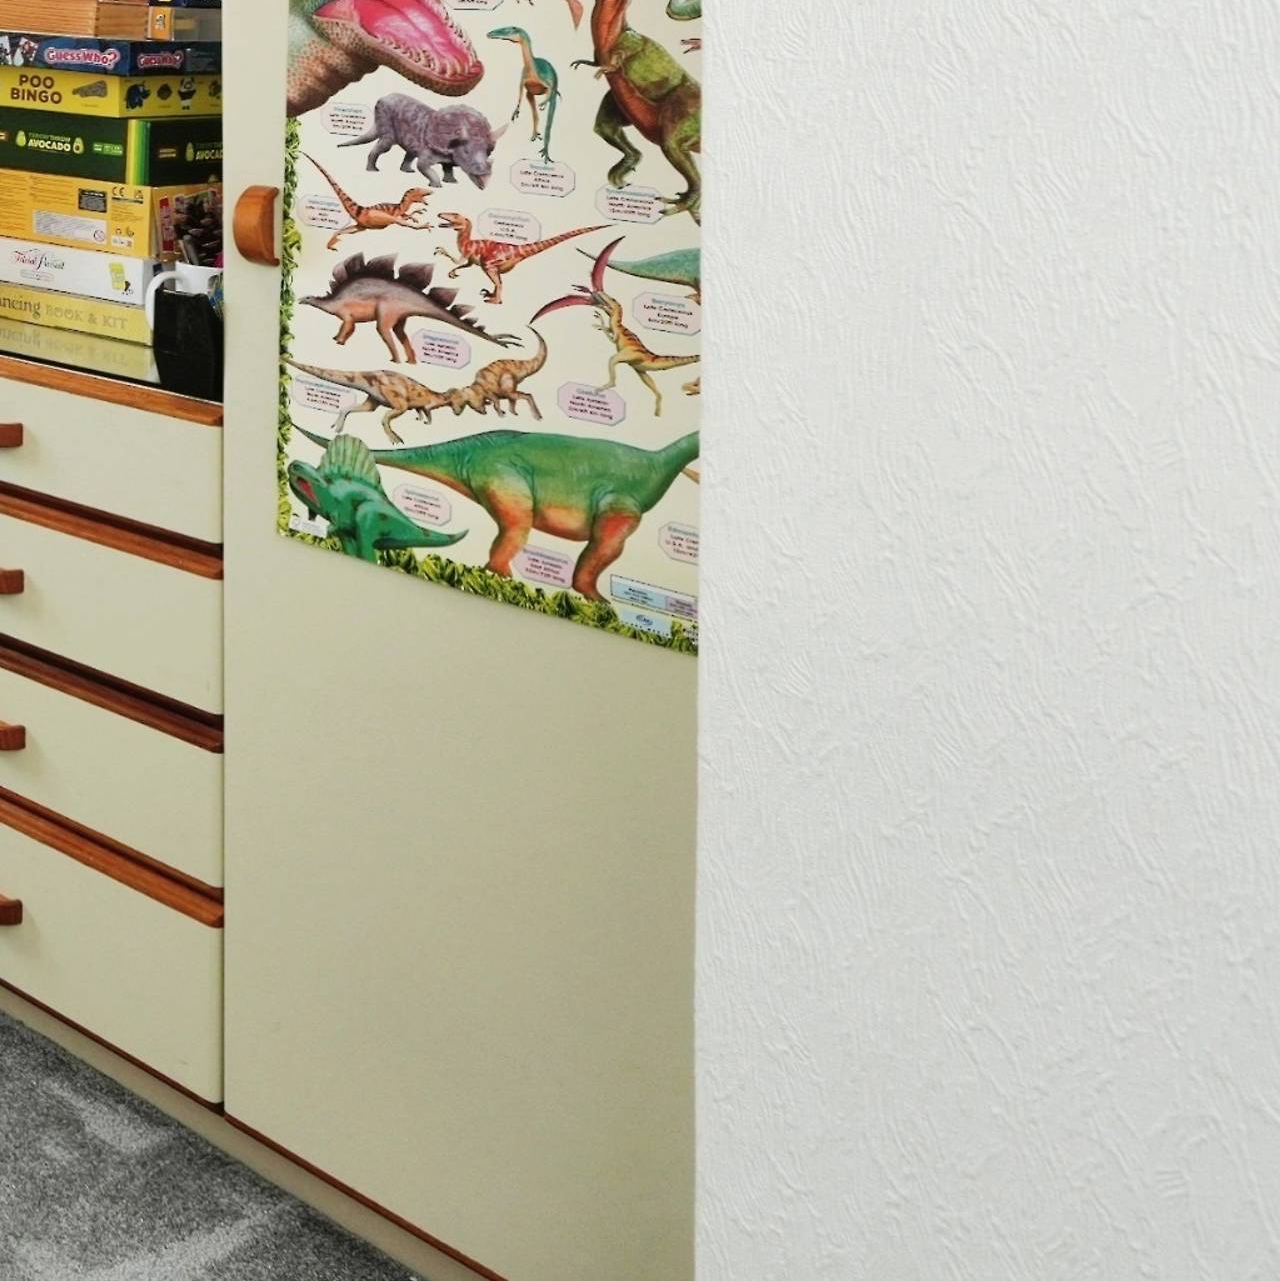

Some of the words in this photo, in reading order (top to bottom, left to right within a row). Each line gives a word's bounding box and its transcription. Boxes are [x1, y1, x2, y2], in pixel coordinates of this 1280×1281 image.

[19, 74, 55, 89] POO
[10, 87, 62, 104] BINGO
[28, 139, 71, 152] AVOCADO
[195, 149, 223, 160] AVOCA
[45, 303, 84, 321] BOOK
[87, 312, 99, 325] &
[101, 315, 129, 330] KIT
